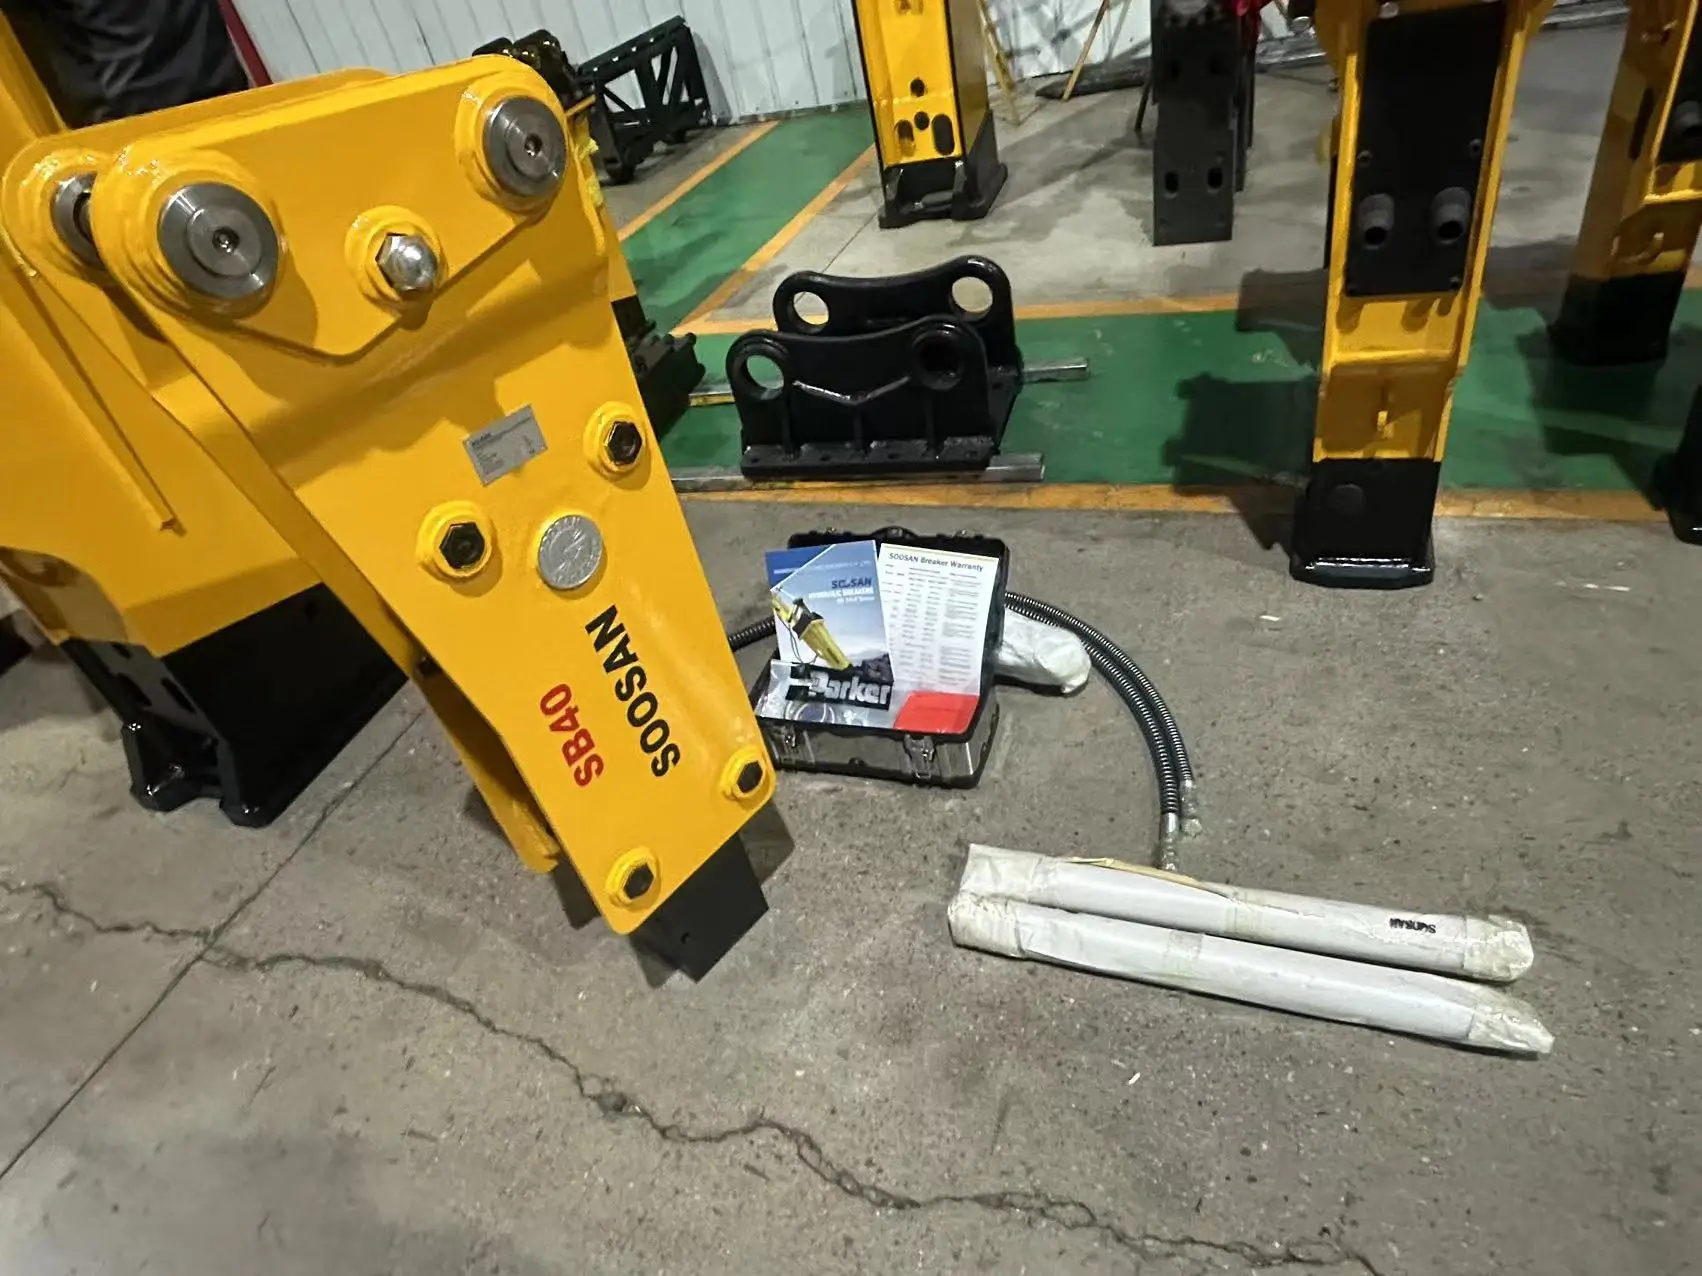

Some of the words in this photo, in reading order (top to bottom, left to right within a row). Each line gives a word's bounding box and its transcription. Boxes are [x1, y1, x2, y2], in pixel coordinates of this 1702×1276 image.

[889, 552, 918, 563] SOOSAN
[920, 556, 949, 567] Breaker
[950, 560, 984, 573] Warranty
[584, 604, 681, 777] SOOSAN
[808, 671, 891, 705] Parker
[540, 683, 605, 787] SB40
